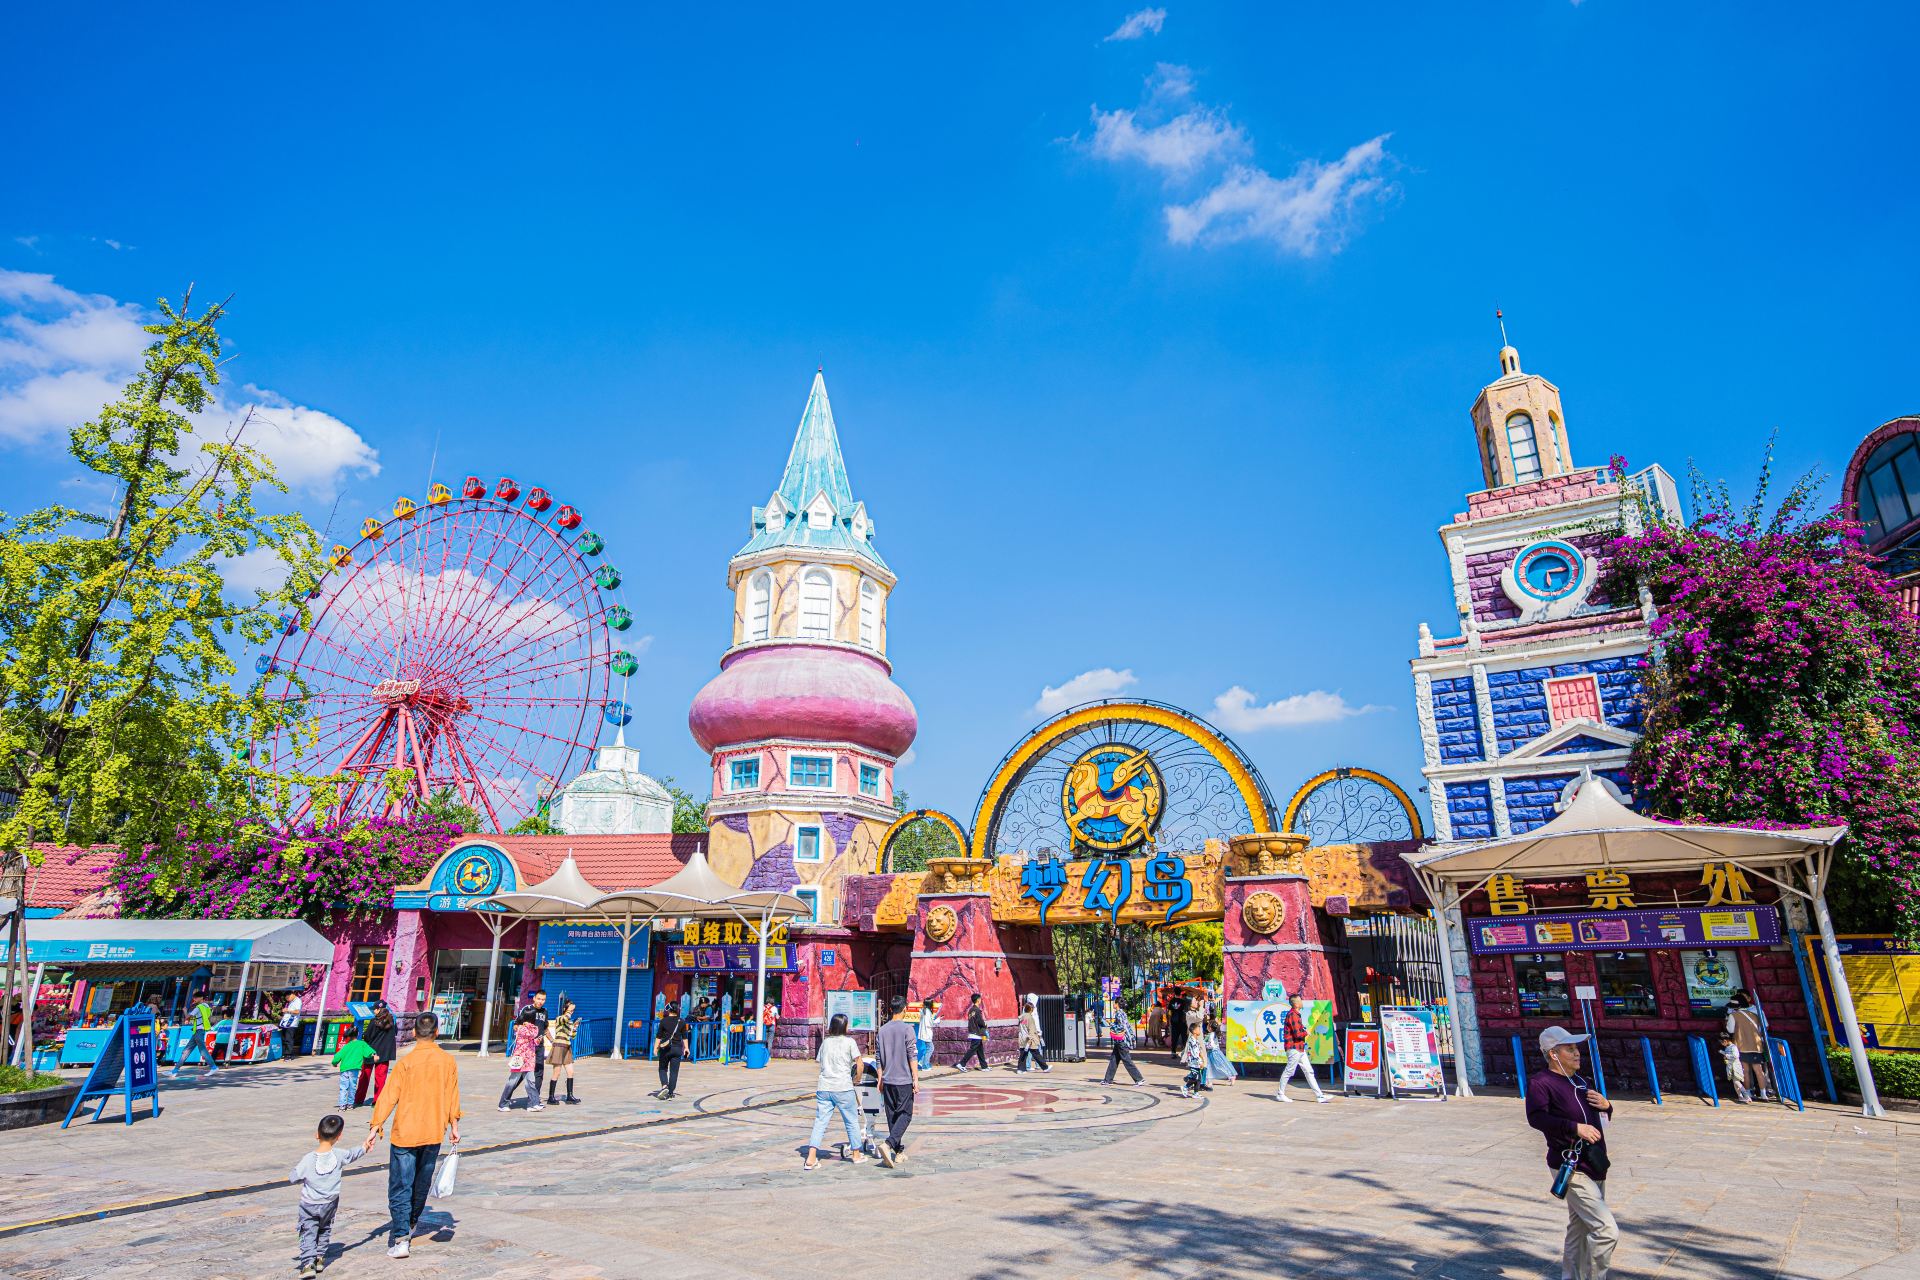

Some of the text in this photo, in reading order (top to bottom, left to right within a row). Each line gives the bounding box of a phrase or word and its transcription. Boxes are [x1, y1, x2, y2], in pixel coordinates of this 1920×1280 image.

[1021, 852, 1193, 927] 梦幻岛
[1485, 863, 1756, 916] 售票处
[683, 917, 789, 945] 网络取票处
[1535, 954, 1543, 963] 3
[1617, 951, 1625, 960] 2
[1706, 949, 1715, 958] 1
